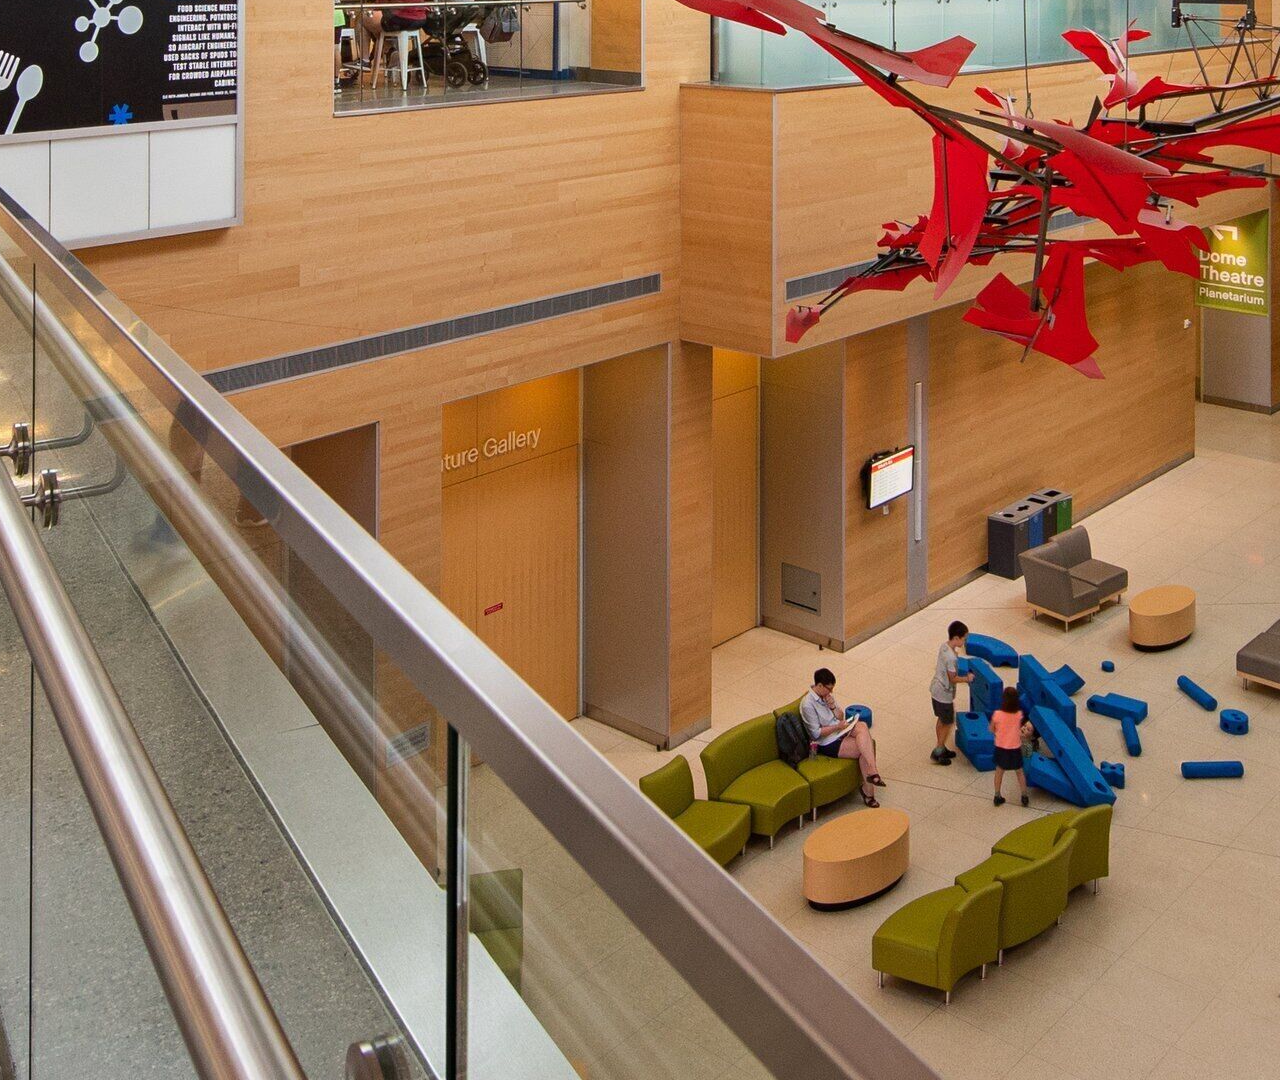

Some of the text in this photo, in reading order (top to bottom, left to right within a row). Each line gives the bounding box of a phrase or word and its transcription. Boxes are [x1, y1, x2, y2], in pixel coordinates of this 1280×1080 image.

[177, 3, 237, 13] FOOD SCIENCE MEETS
[210, 13, 237, 21] POTATOES
[177, 23, 205, 32] INTERACT
[206, 23, 221, 31] WITH
[172, 33, 197, 42] SIGNALS
[198, 33, 210, 41] LIKE
[168, 41, 237, 52] SO AIRCRAFT ENGINEERS
[163, 50, 237, 61] USED SACKS OF SPUDS TO
[173, 60, 237, 71] TEST STABLE INTERNET
[168, 70, 237, 81] FOR CROWDED AIRPLANE
[1200, 249, 1247, 267] Dome
[1200, 264, 1265, 287] Theatre
[1199, 287, 1265, 306] Planetarium
[440, 427, 541, 472] ture Gallery
